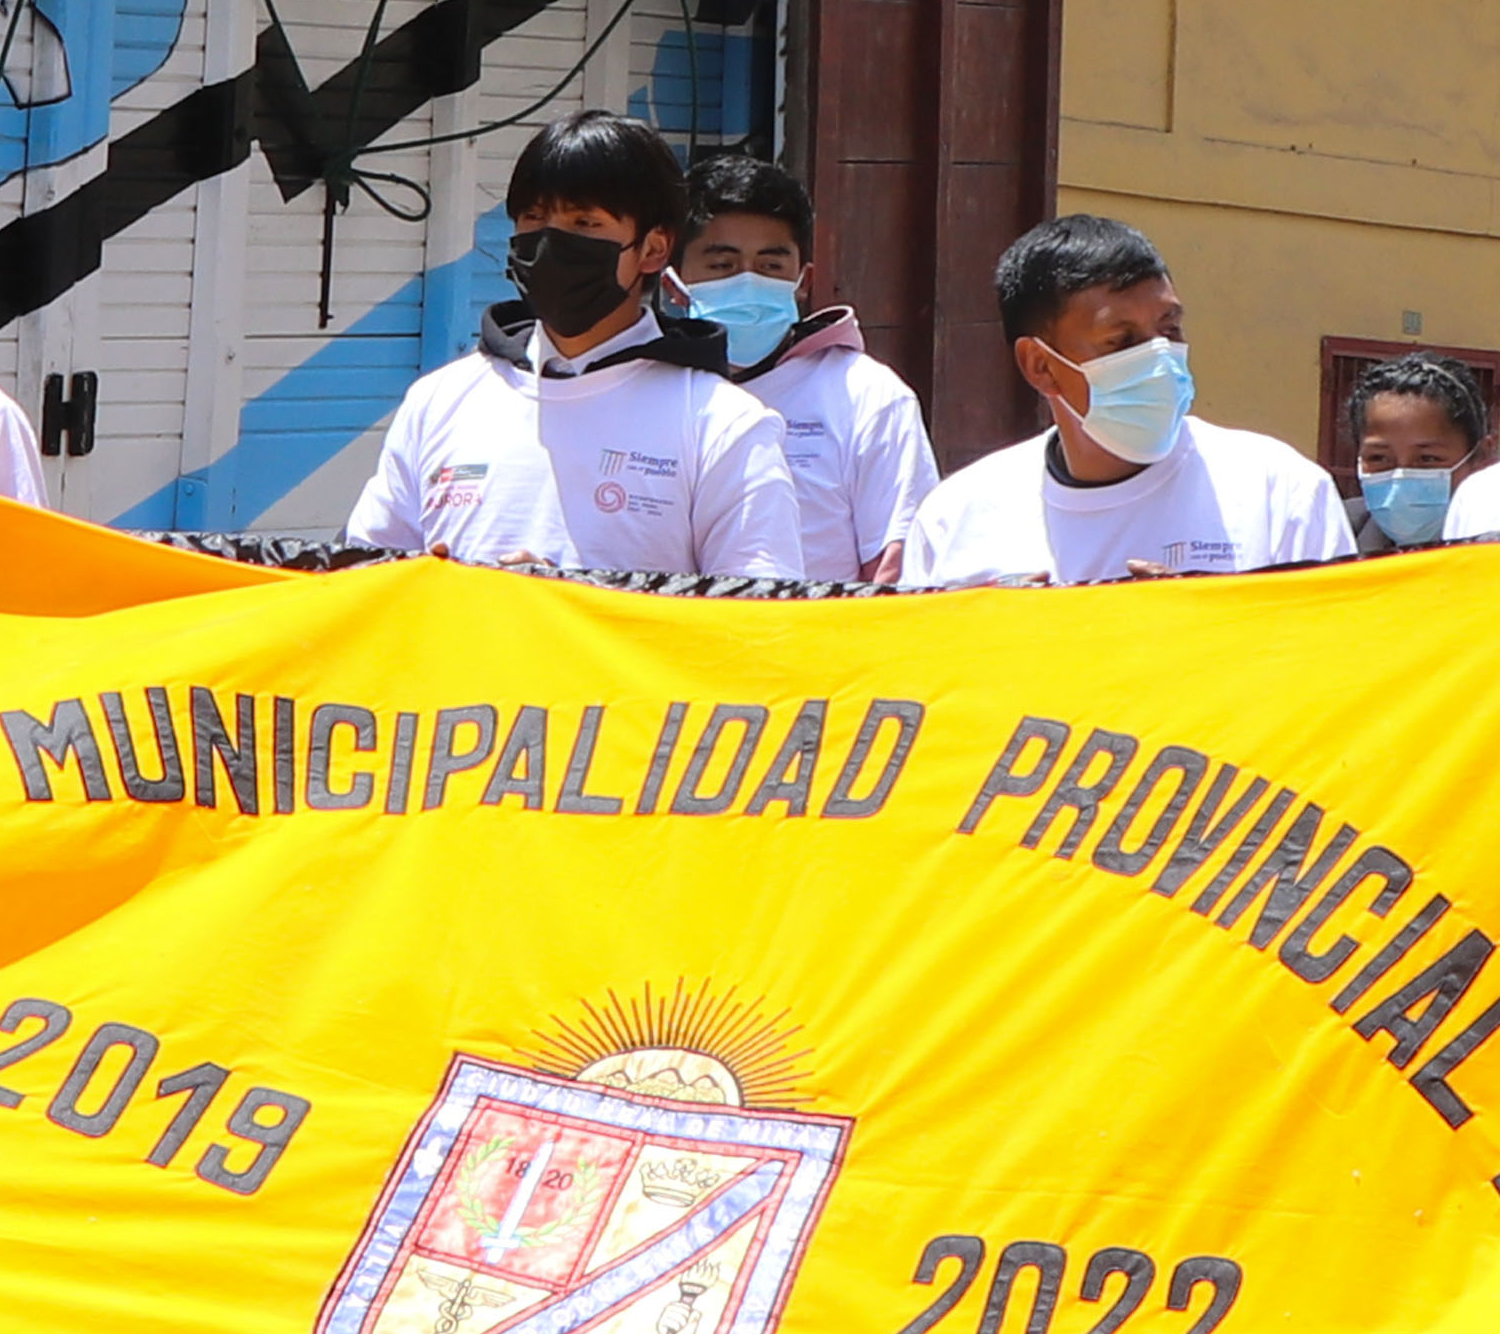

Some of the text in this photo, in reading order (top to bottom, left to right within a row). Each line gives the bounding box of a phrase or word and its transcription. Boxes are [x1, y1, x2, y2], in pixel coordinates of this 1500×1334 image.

[628, 450, 679, 468] Siempre
[465, 1070, 583, 1114] CIUDAD
[505, 1157, 575, 1190] 18 20
